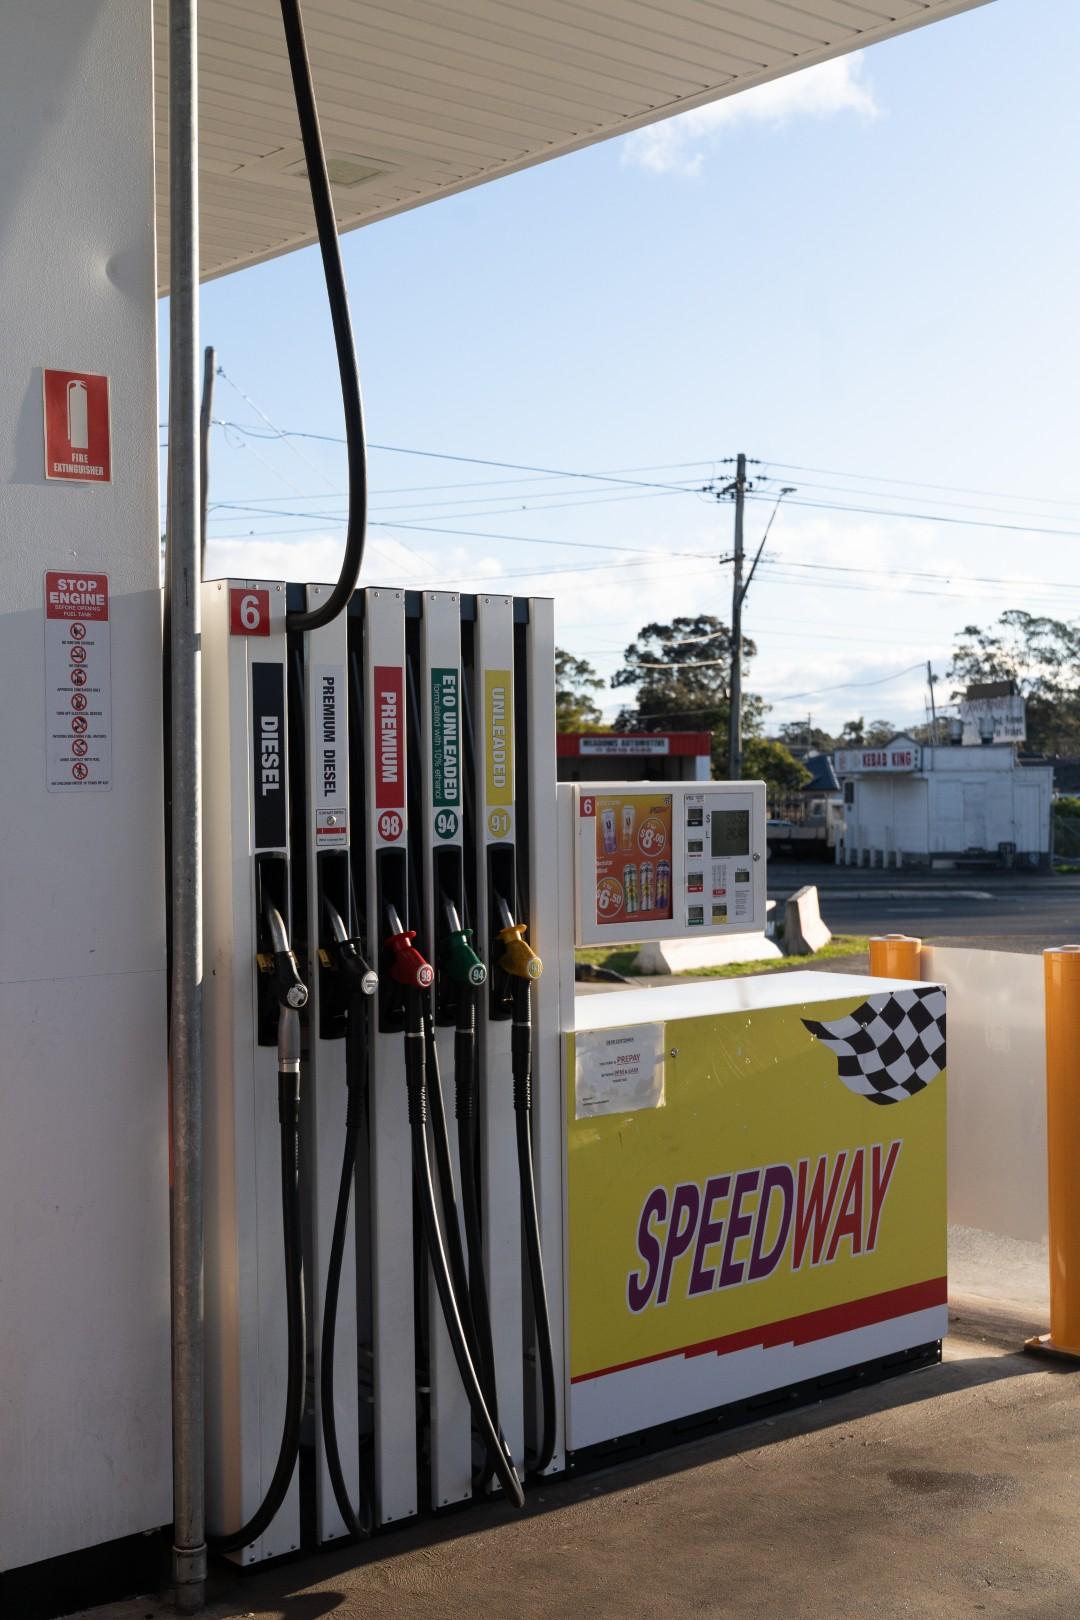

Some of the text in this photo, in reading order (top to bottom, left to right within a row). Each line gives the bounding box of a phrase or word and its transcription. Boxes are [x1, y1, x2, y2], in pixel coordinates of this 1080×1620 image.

[71, 452, 89, 463] FIRE
[53, 462, 104, 476] EXTINGUISHER
[57, 578, 97, 592] STOP
[49, 591, 105, 606] ENGINE
[239, 594, 261, 630] 6
[321, 676, 336, 744] PREMIUM
[433, 684, 442, 727] formulated
[379, 691, 397, 784] PREMIUM
[433, 728, 442, 746] with
[442, 675, 458, 801] E10 UNLEADED
[491, 686, 506, 789] UNLEADED
[260, 715, 281, 797] DIESEL
[433, 749, 442, 767] 10%
[862, 751, 887, 768] KEBAB
[891, 751, 912, 768] KING
[323, 749, 337, 798] DIESEL
[583, 798, 593, 814] 6
[380, 815, 400, 836] 98
[437, 815, 457, 834] 94
[489, 813, 509, 833] 91
[421, 969, 431, 982] 98
[473, 969, 484, 981] 94
[617, 1053, 640, 1063] PREPAY
[627, 1140, 904, 1314] SPEEDWAY
